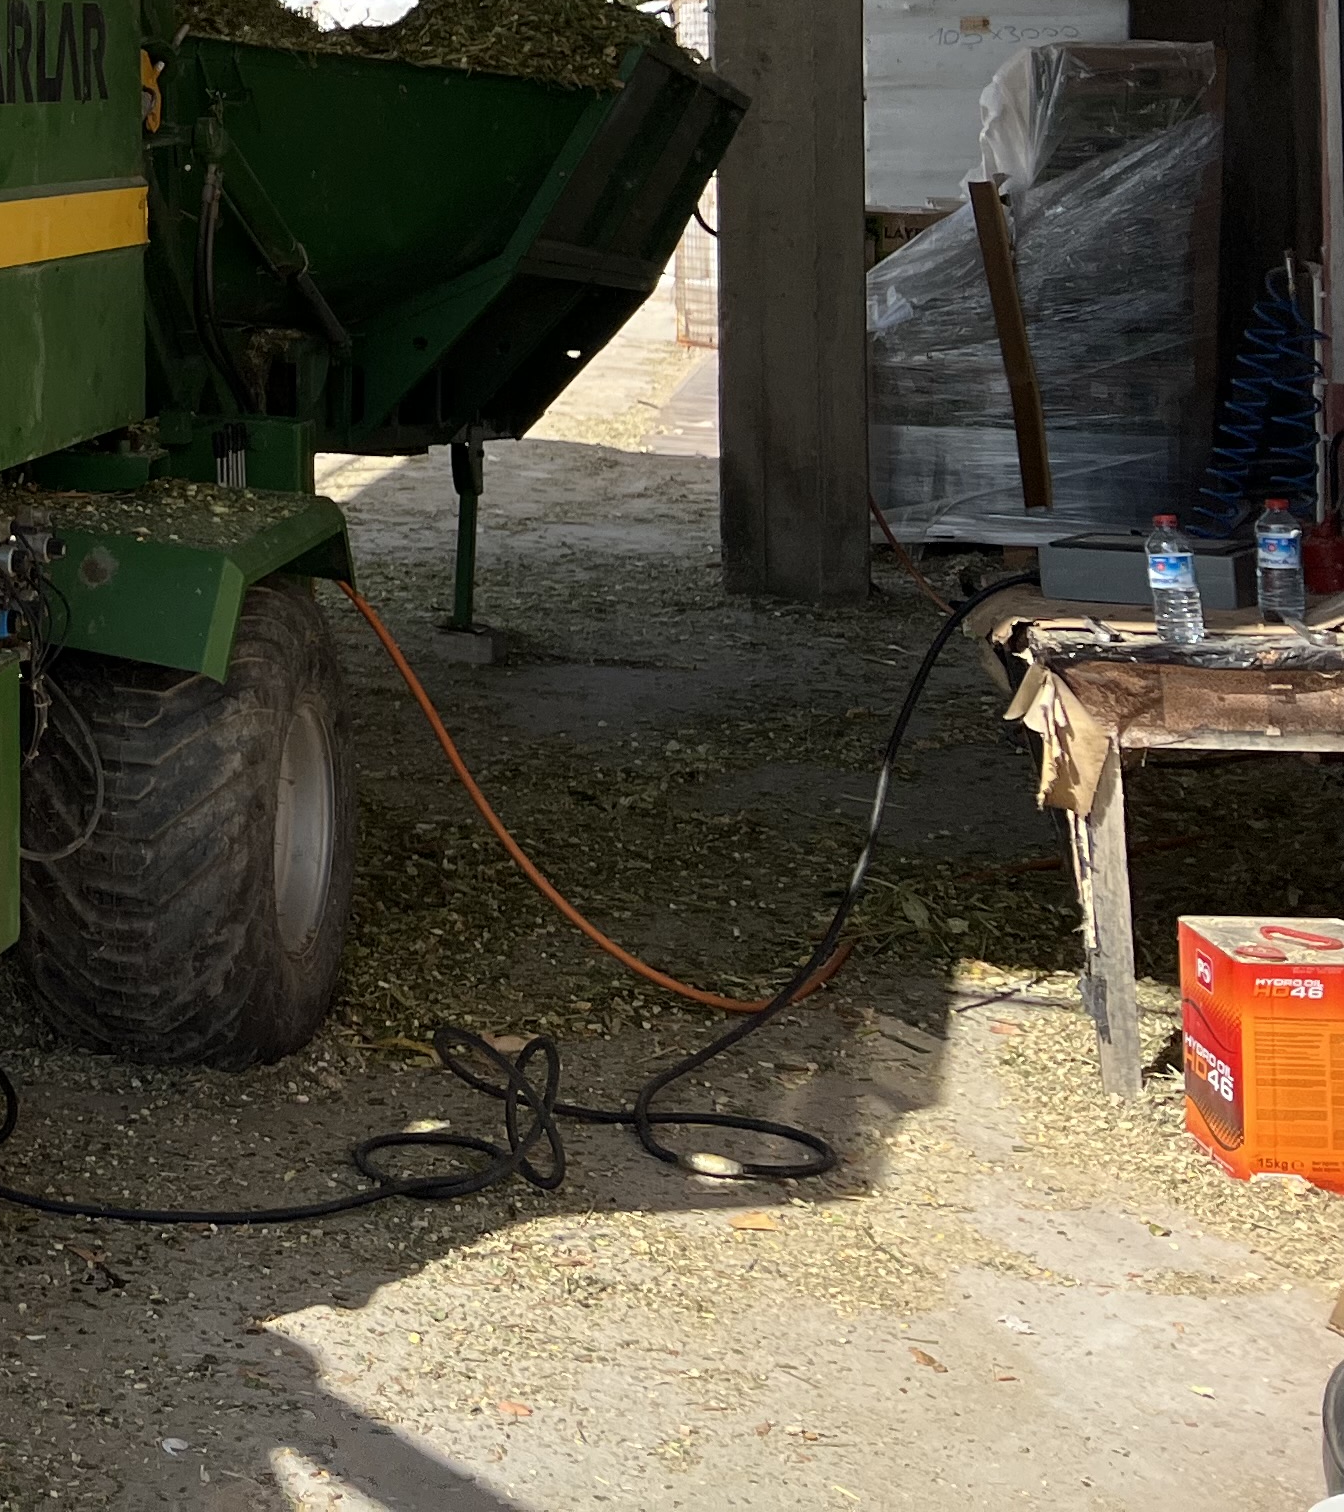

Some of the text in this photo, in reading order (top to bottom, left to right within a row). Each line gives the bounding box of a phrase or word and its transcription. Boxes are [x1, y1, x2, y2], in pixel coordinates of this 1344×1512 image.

[1255, 978, 1303, 987] HYDRO
[1184, 1031, 1234, 1082] HYDRO OIL
